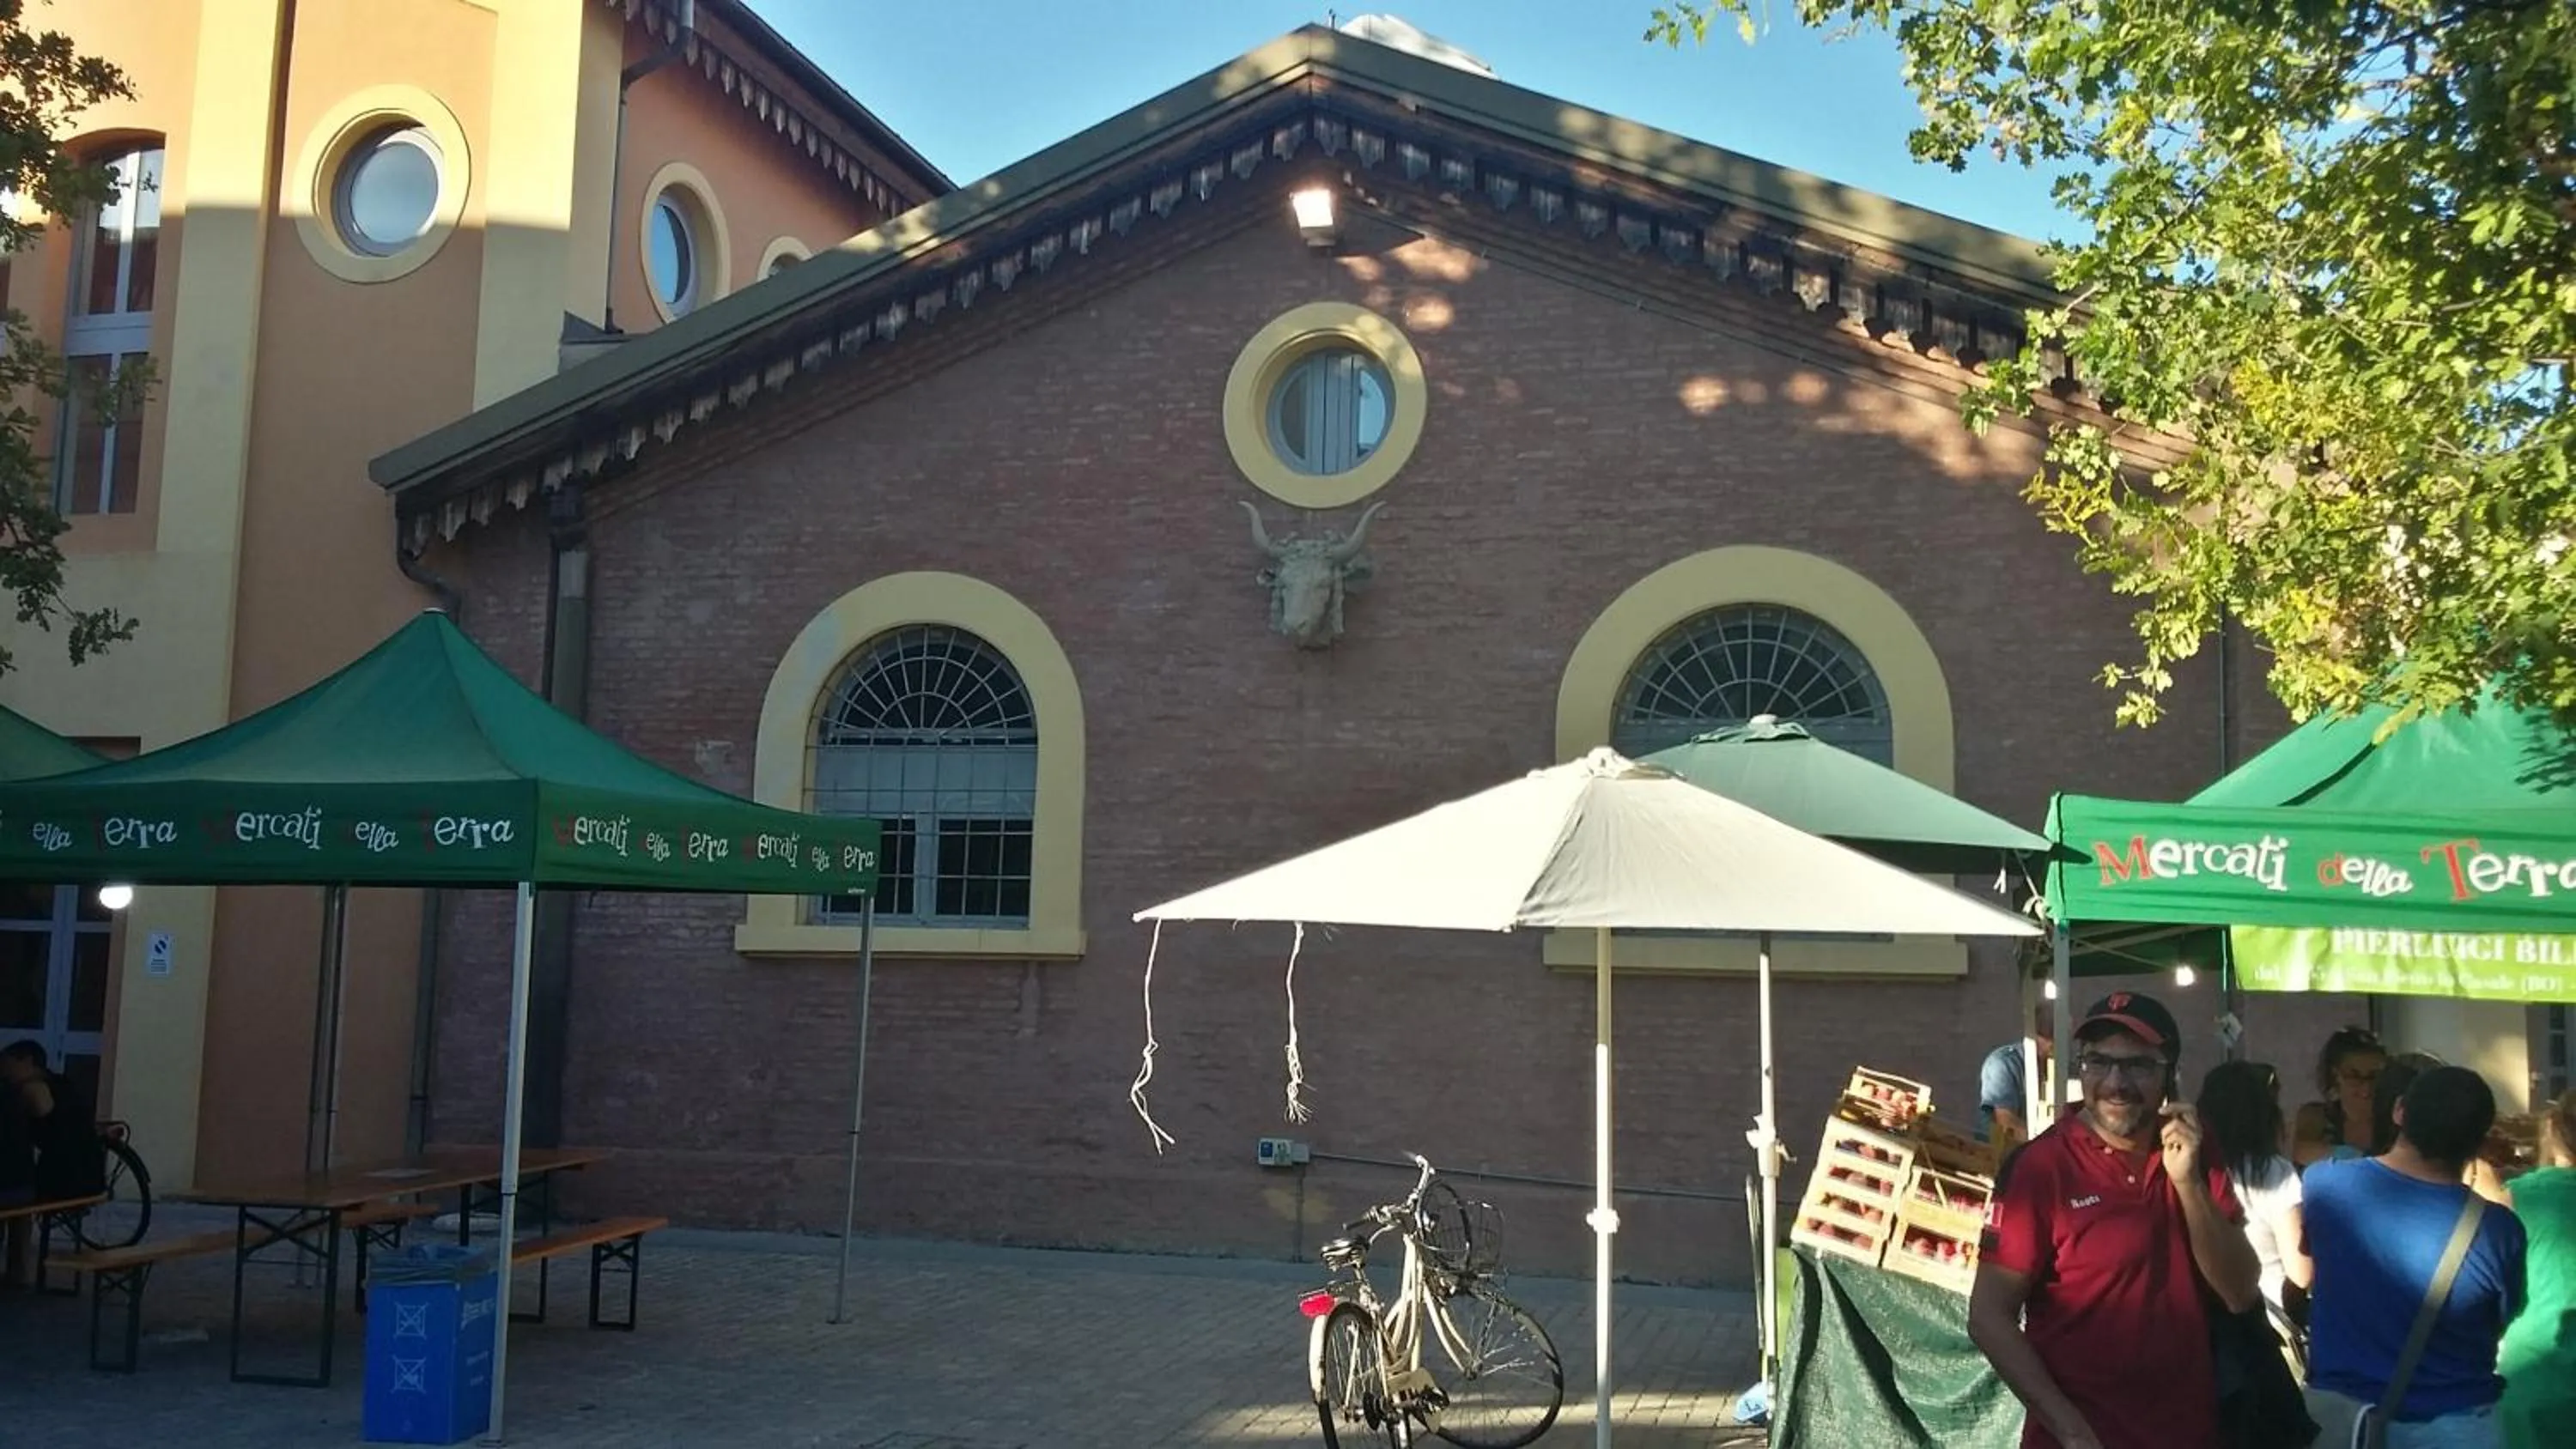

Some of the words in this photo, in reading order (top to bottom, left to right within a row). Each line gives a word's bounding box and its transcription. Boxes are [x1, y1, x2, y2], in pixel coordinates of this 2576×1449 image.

[346, 821, 399, 852] ella
[2092, 834, 2289, 892] Mercati
[2318, 852, 2414, 897] della
[2515, 932, 2576, 965] BIL
